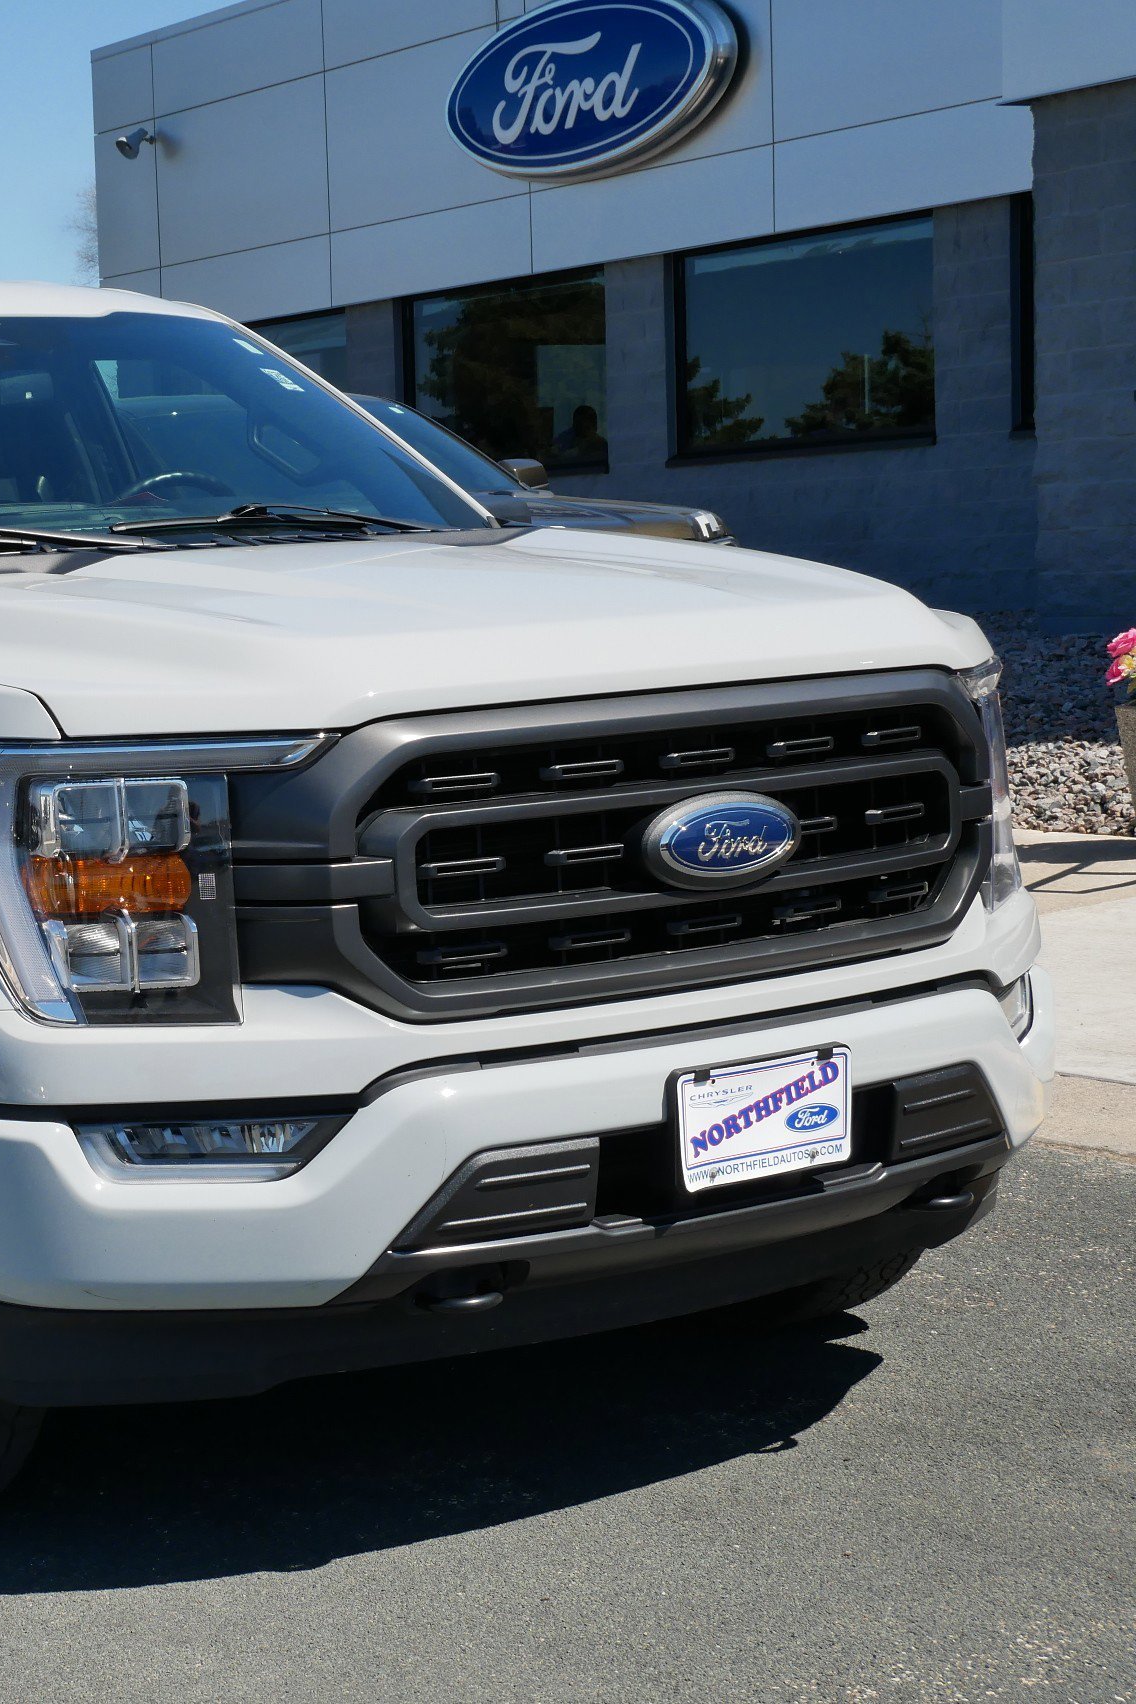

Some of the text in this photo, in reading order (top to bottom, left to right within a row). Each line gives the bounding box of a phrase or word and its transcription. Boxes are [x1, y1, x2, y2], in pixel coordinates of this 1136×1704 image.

[492, 31, 642, 145] Ford
[697, 819, 768, 862] Ford
[689, 1084, 753, 1101] CHRYSLER
[690, 1061, 840, 1159] NORTHFIELD
[794, 1107, 828, 1128] Ford
[687, 1143, 843, 1184] WWWNORTHFIELDAUTOSCOM
